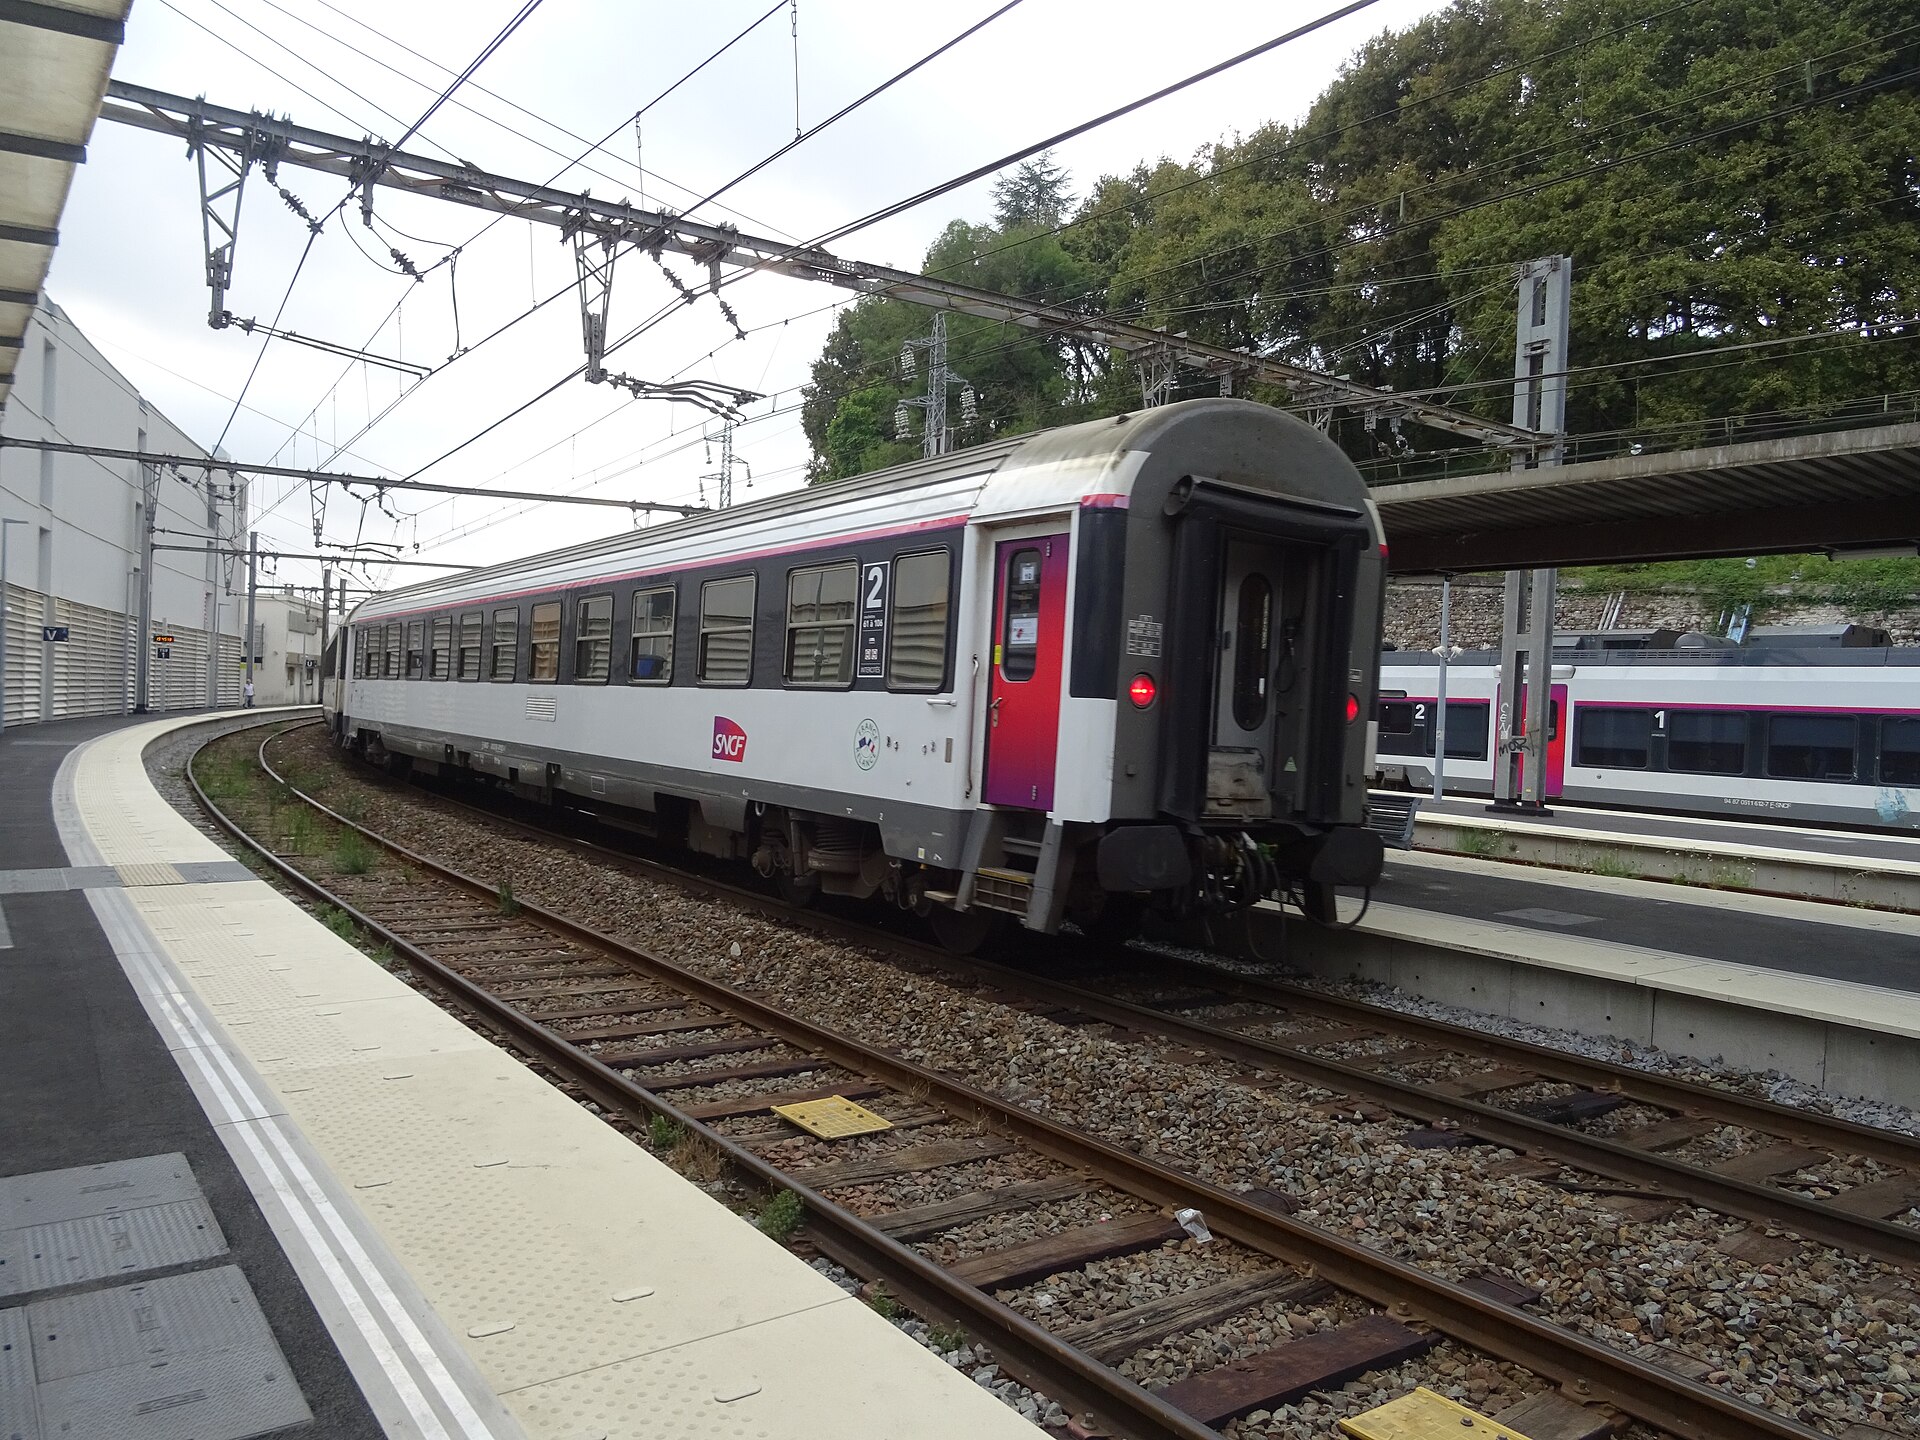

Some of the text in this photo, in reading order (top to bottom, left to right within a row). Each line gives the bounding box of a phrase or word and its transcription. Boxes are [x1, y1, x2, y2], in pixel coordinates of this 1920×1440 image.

[866, 566, 883, 608] 2
[46, 629, 57, 641] V
[1414, 703, 1425, 720] 2
[1654, 710, 1665, 729] 1
[713, 733, 746, 756] SNCF
